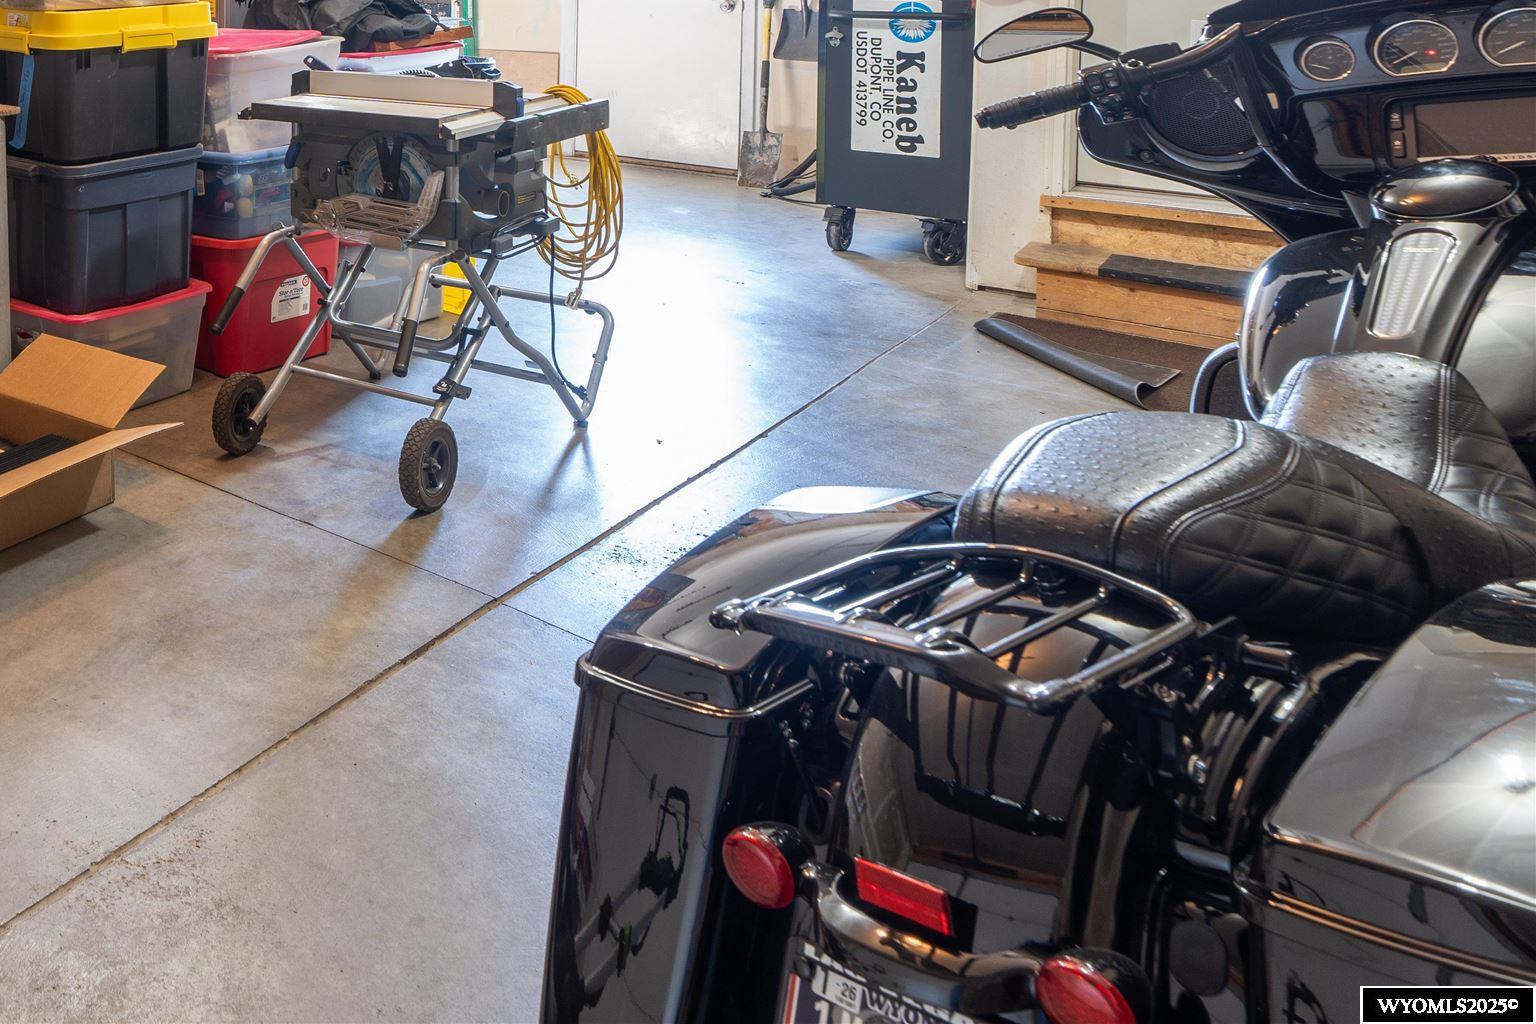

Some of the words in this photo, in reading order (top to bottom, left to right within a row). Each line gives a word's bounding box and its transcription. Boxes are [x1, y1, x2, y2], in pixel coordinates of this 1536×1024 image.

[856, 31, 868, 75] USDOT
[869, 37, 882, 95] DUPONT,
[882, 58, 895, 83] PIPE
[855, 80, 868, 127] 413799
[869, 101, 882, 122] CO
[882, 88, 894, 114] LINE
[895, 50, 926, 154] Kaneb
[882, 120, 894, 143] CO.
